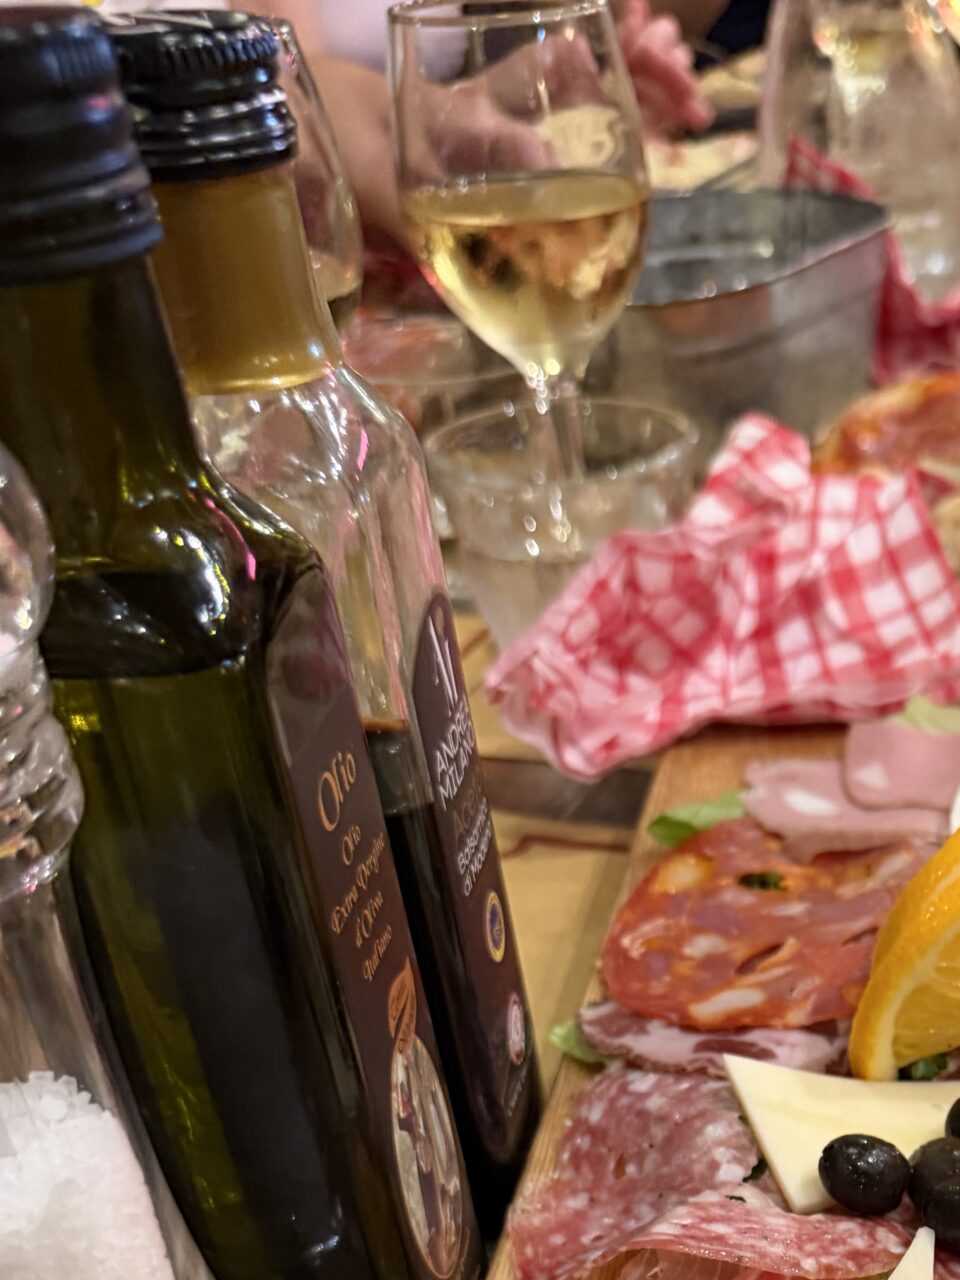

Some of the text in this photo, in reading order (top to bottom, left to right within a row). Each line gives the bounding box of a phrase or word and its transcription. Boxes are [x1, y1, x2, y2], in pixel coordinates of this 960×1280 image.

[318, 752, 357, 832] Olio
[439, 719, 474, 812] MILANO
[341, 825, 362, 867] Olio
